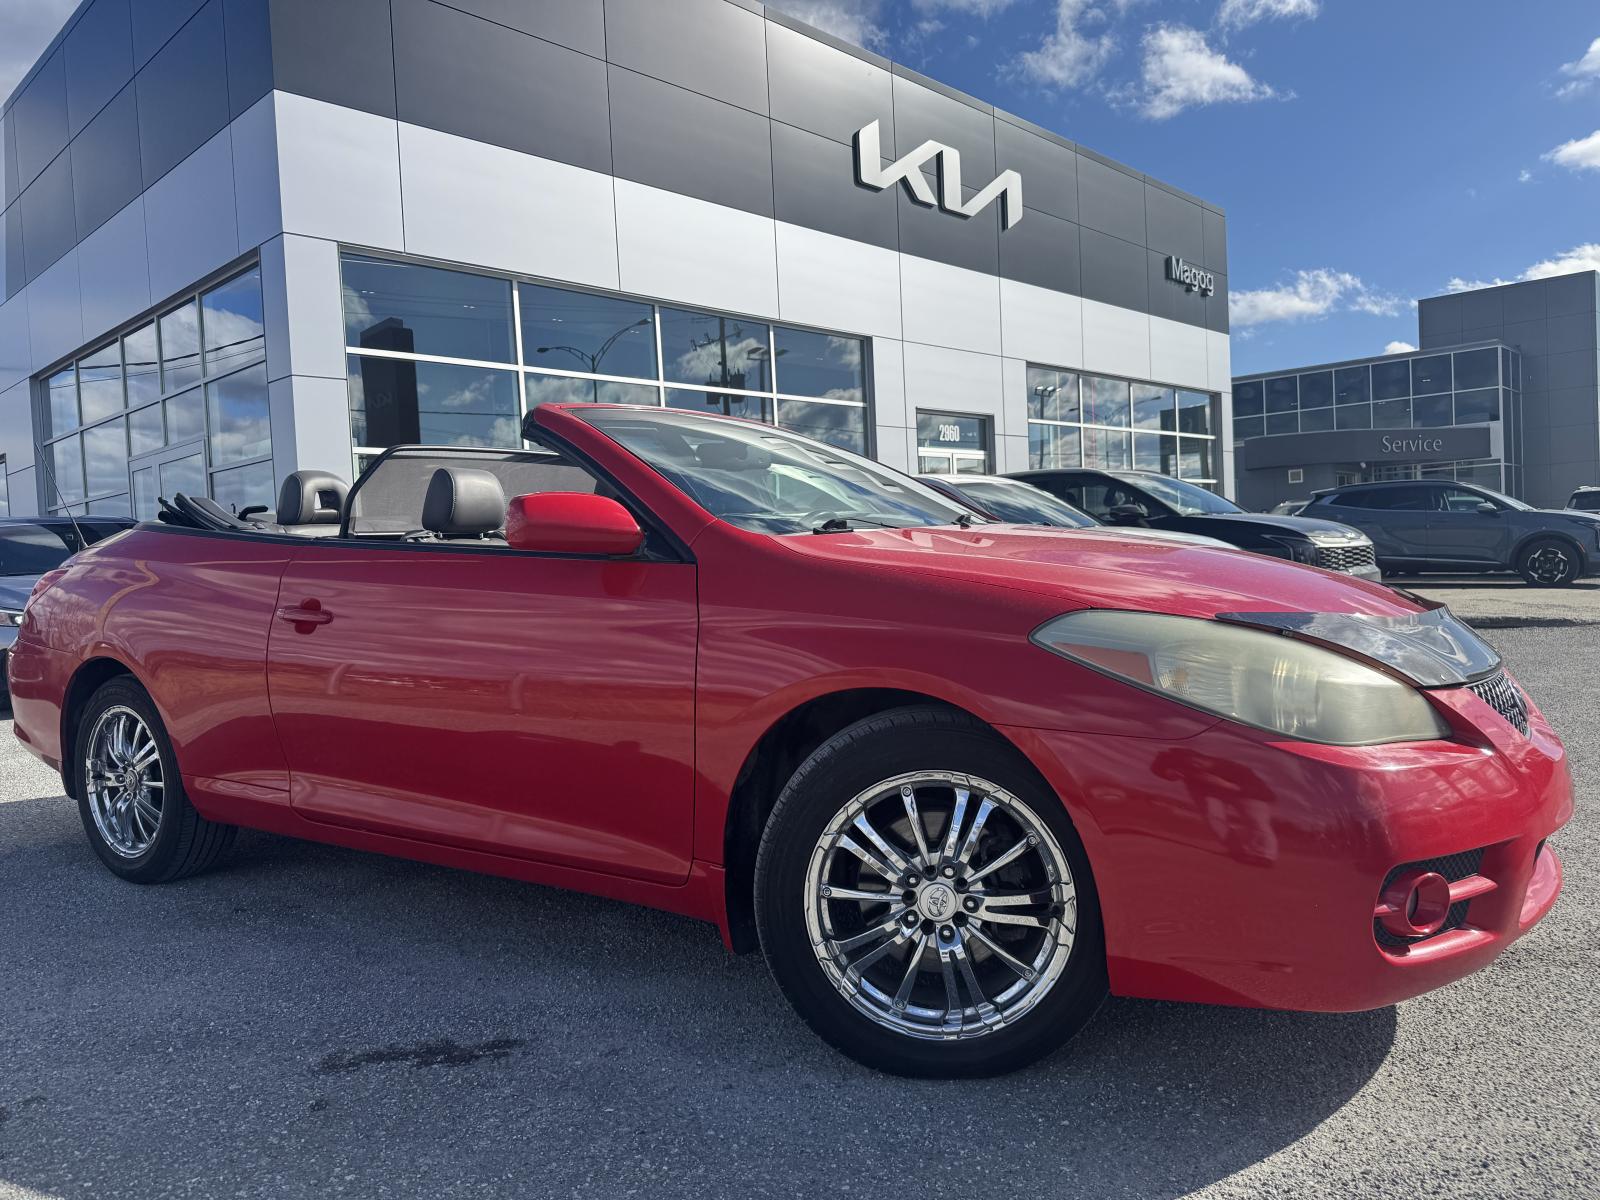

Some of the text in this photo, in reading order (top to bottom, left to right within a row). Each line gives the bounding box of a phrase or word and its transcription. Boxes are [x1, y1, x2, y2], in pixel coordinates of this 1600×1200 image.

[854, 118, 1023, 229] KIA
[1171, 255, 1214, 297] Magog
[1382, 434, 1442, 453] Service
